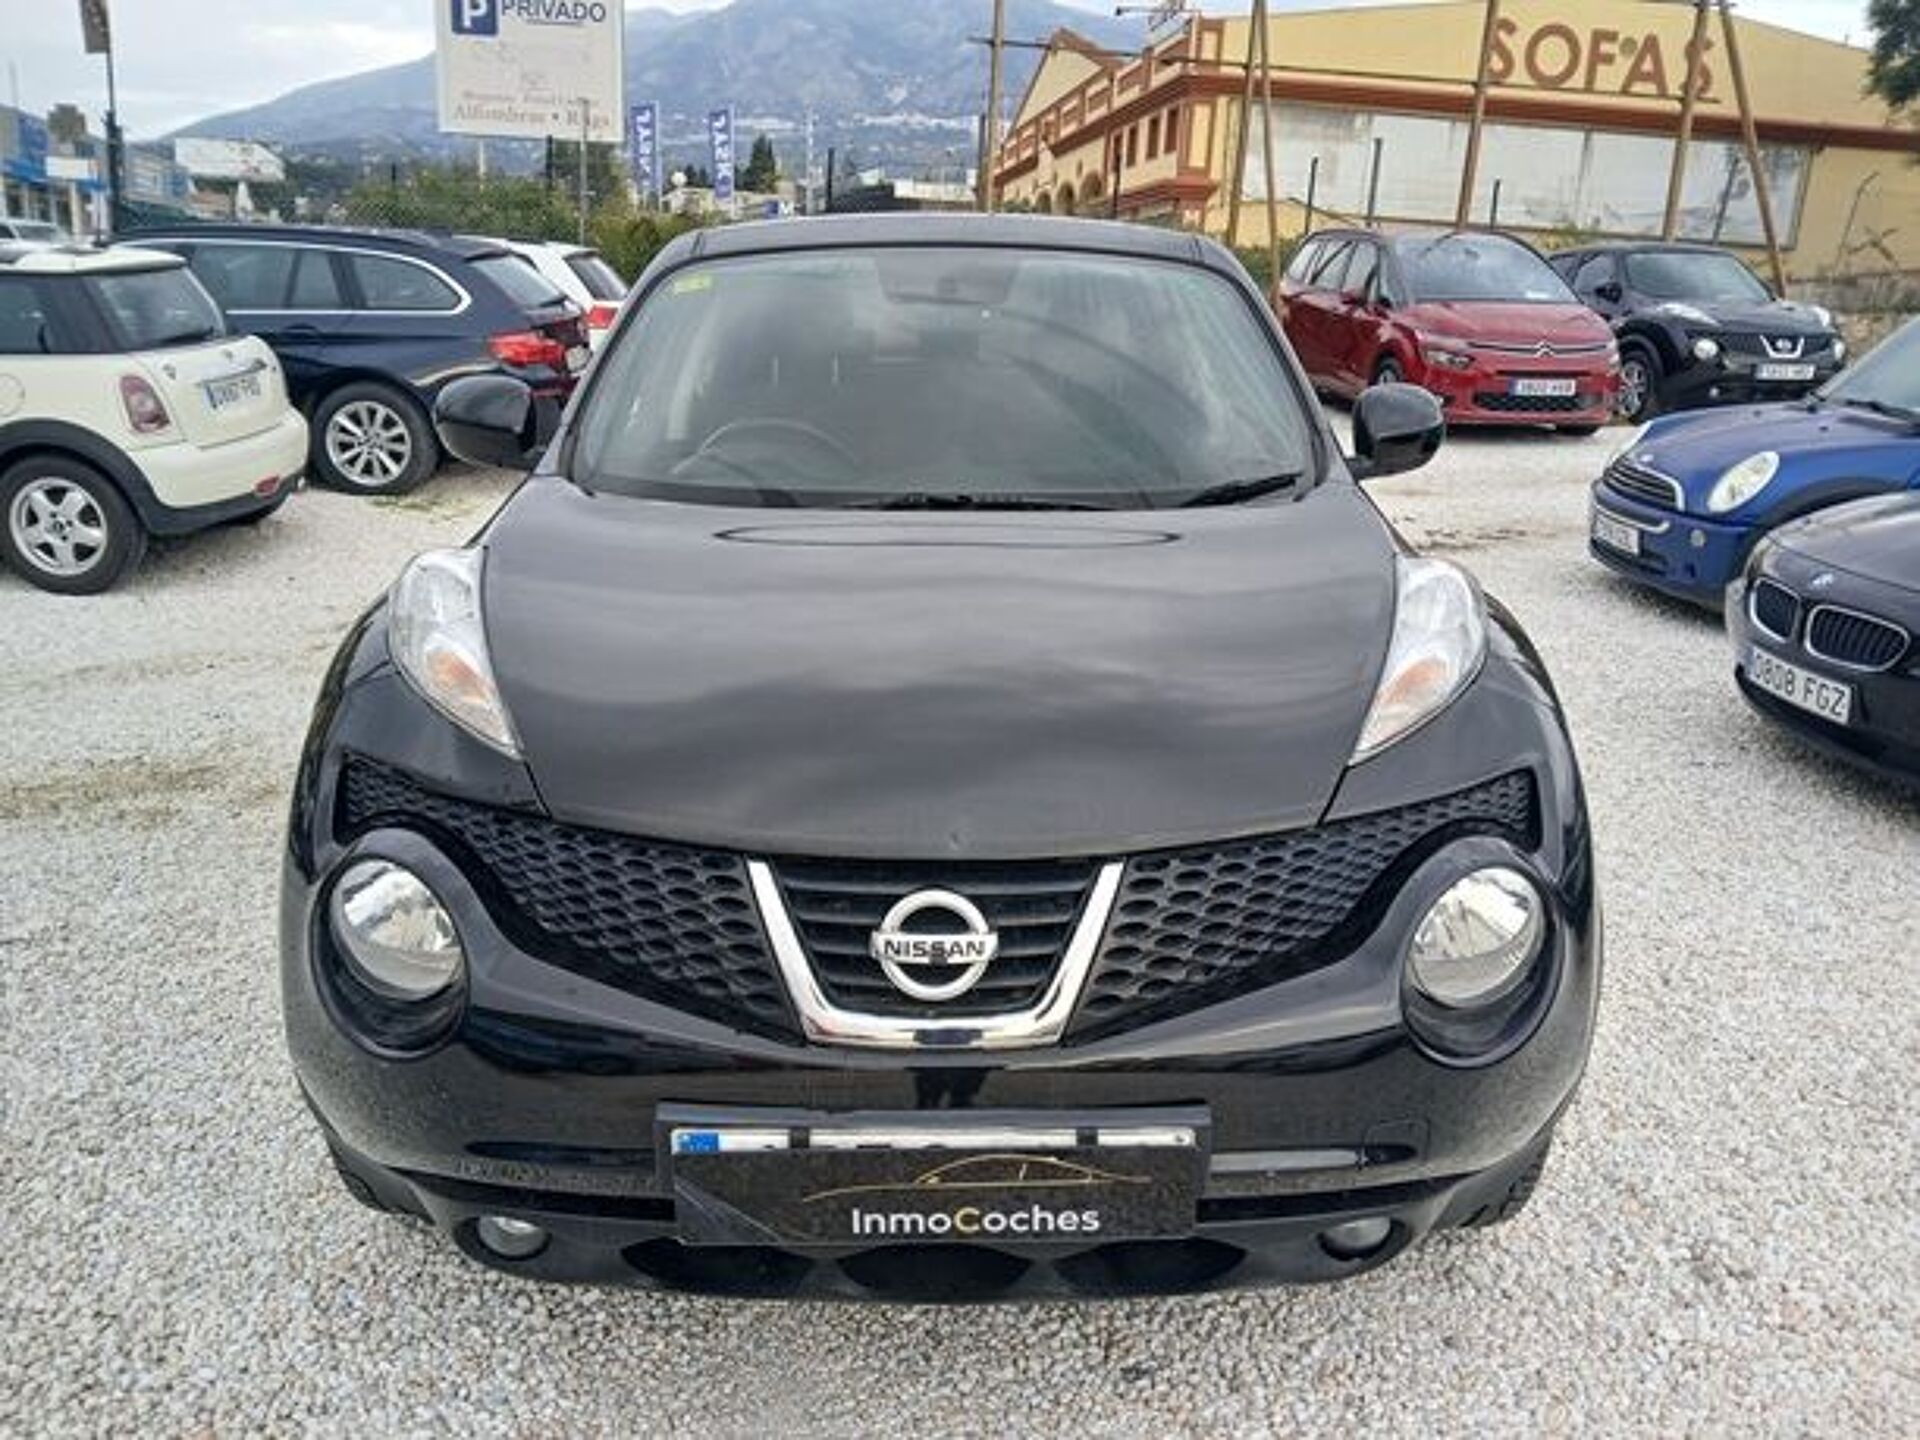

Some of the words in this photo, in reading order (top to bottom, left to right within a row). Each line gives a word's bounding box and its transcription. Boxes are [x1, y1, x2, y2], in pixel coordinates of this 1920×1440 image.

[502, 0, 607, 23] PRIVADO
[1487, 18, 1713, 97] SOFAS
[1803, 677, 1846, 717] FGZ
[883, 939, 987, 958] NISSAN
[851, 1203, 1102, 1235] InmoCoches
